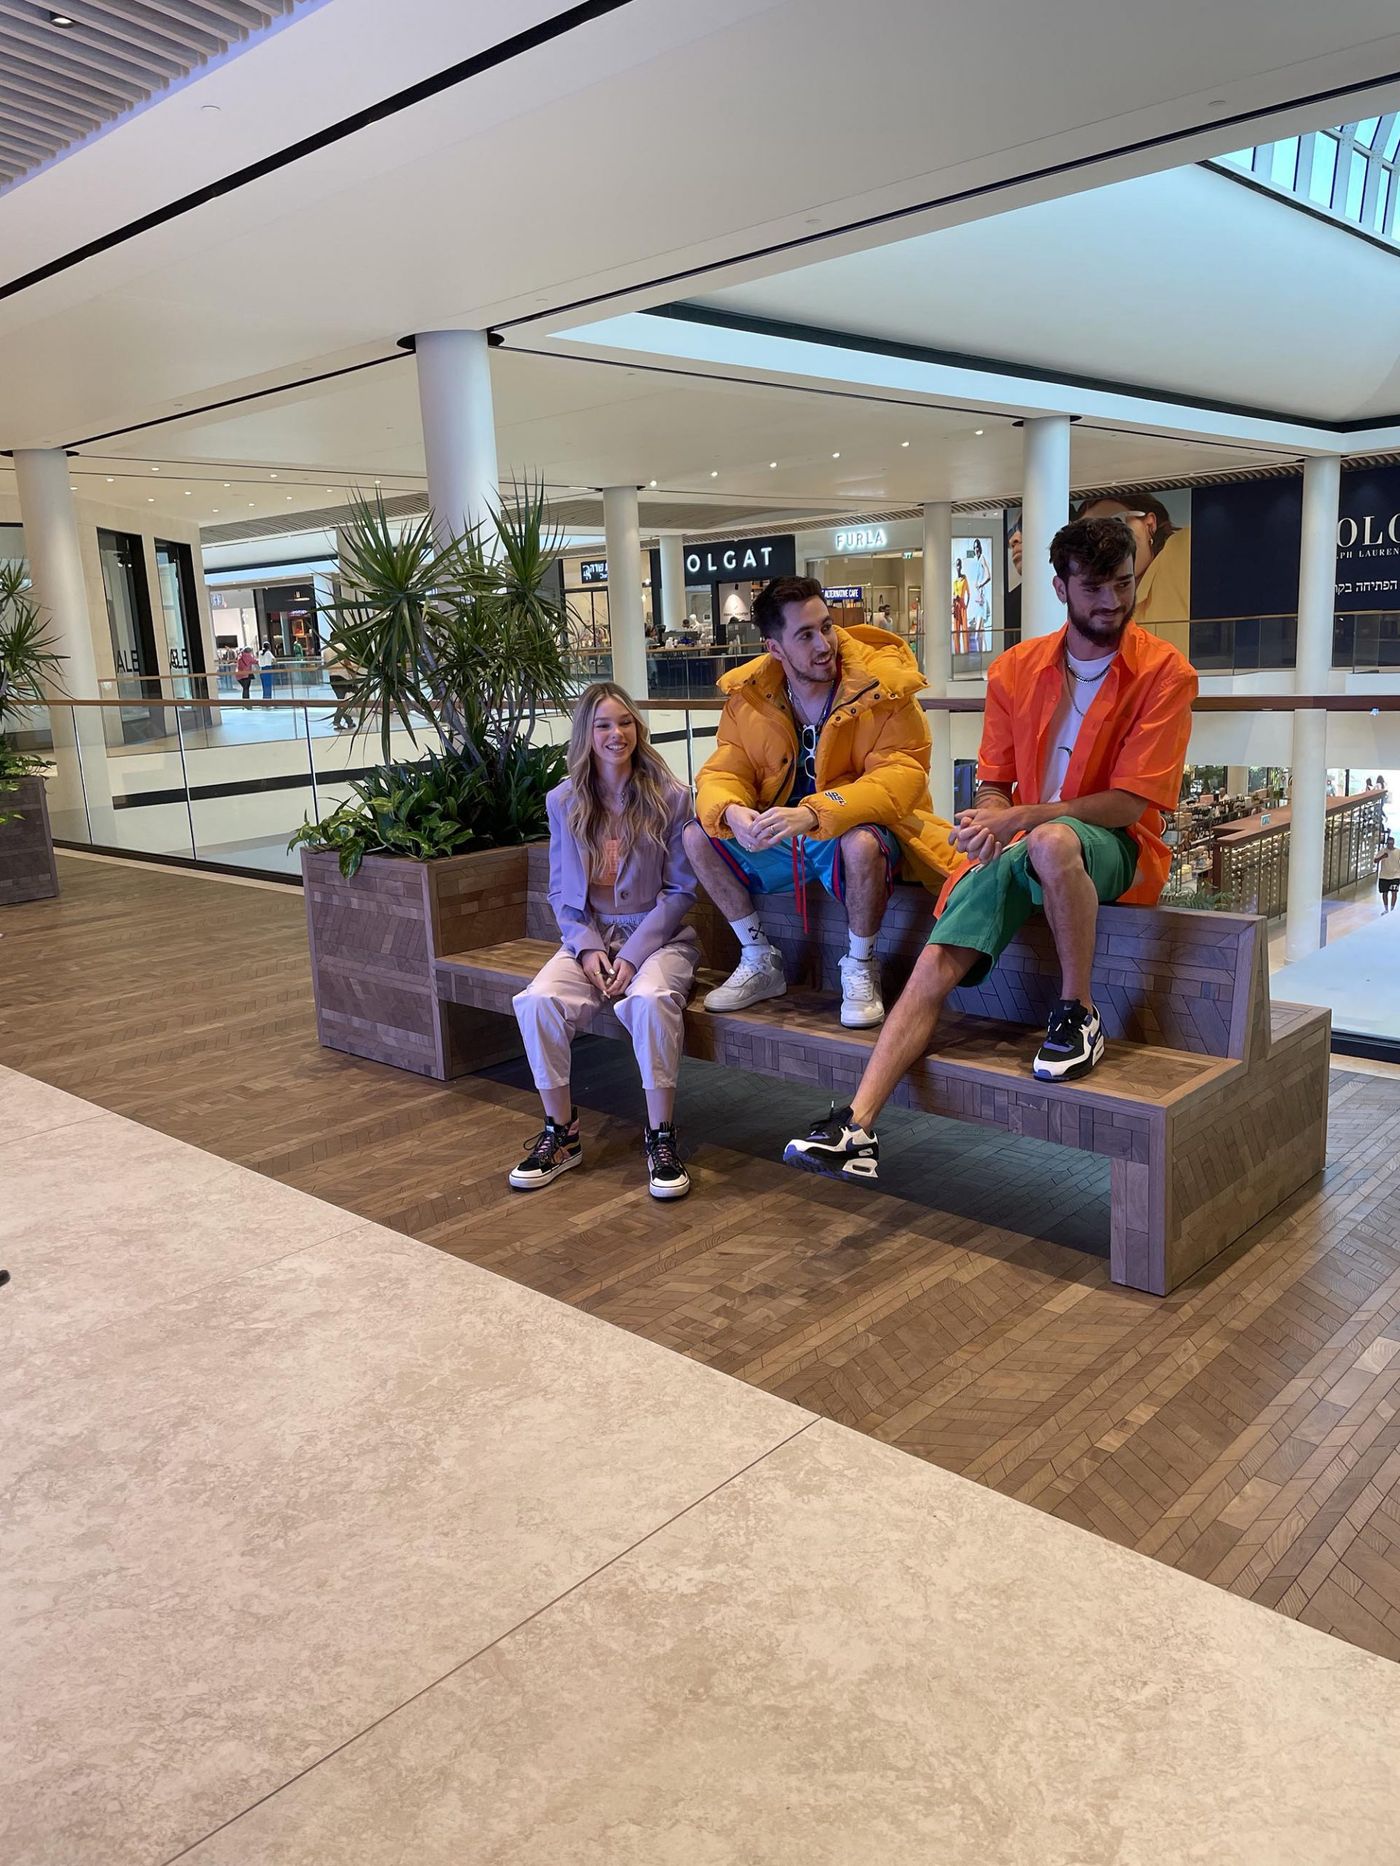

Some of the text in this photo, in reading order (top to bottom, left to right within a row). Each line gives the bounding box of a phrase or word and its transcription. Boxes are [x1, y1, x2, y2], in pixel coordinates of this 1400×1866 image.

[836, 530, 884, 548] FURLA
[686, 547, 773, 572] OLGAT
[1336, 551, 1353, 560] PH
[1355, 580, 1398, 592] הפתיחה
